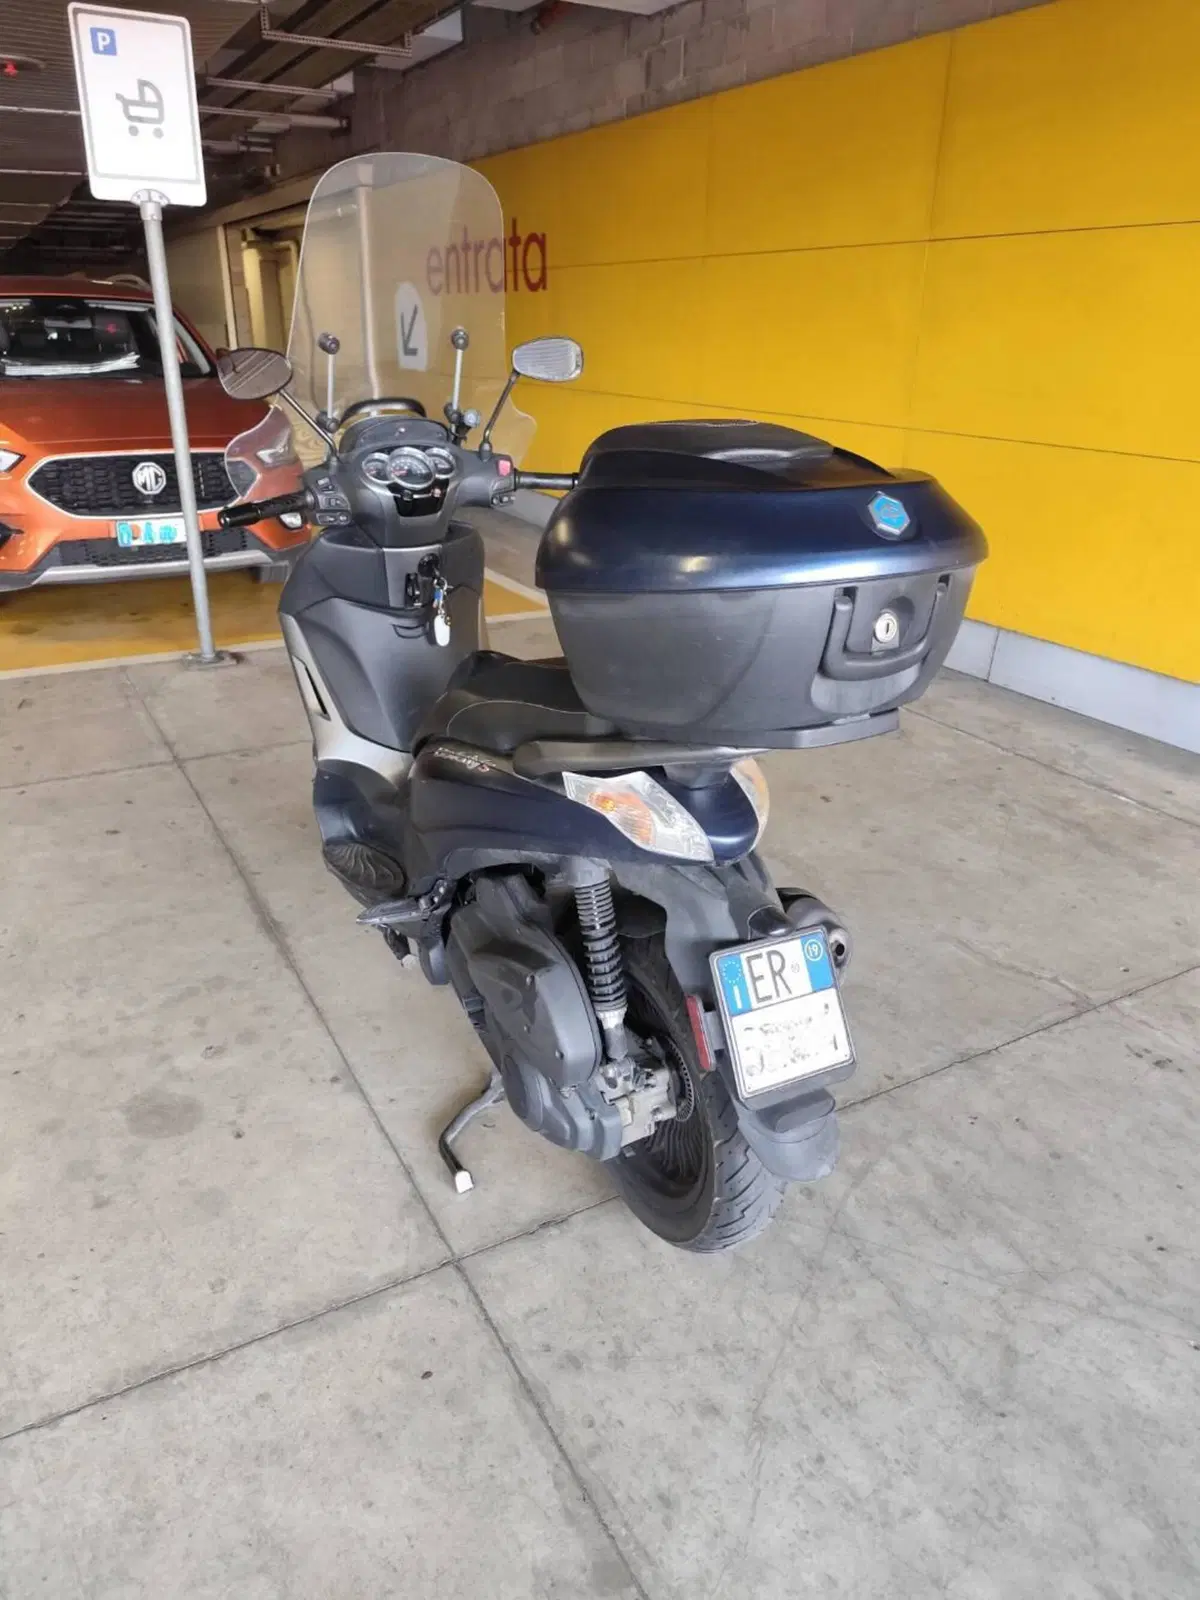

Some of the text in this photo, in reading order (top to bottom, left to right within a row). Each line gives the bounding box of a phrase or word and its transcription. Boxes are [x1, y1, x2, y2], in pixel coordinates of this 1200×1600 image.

[97, 32, 111, 52] P
[426, 217, 548, 296] entrata
[135, 464, 164, 493] MG
[745, 949, 793, 1004] ER
